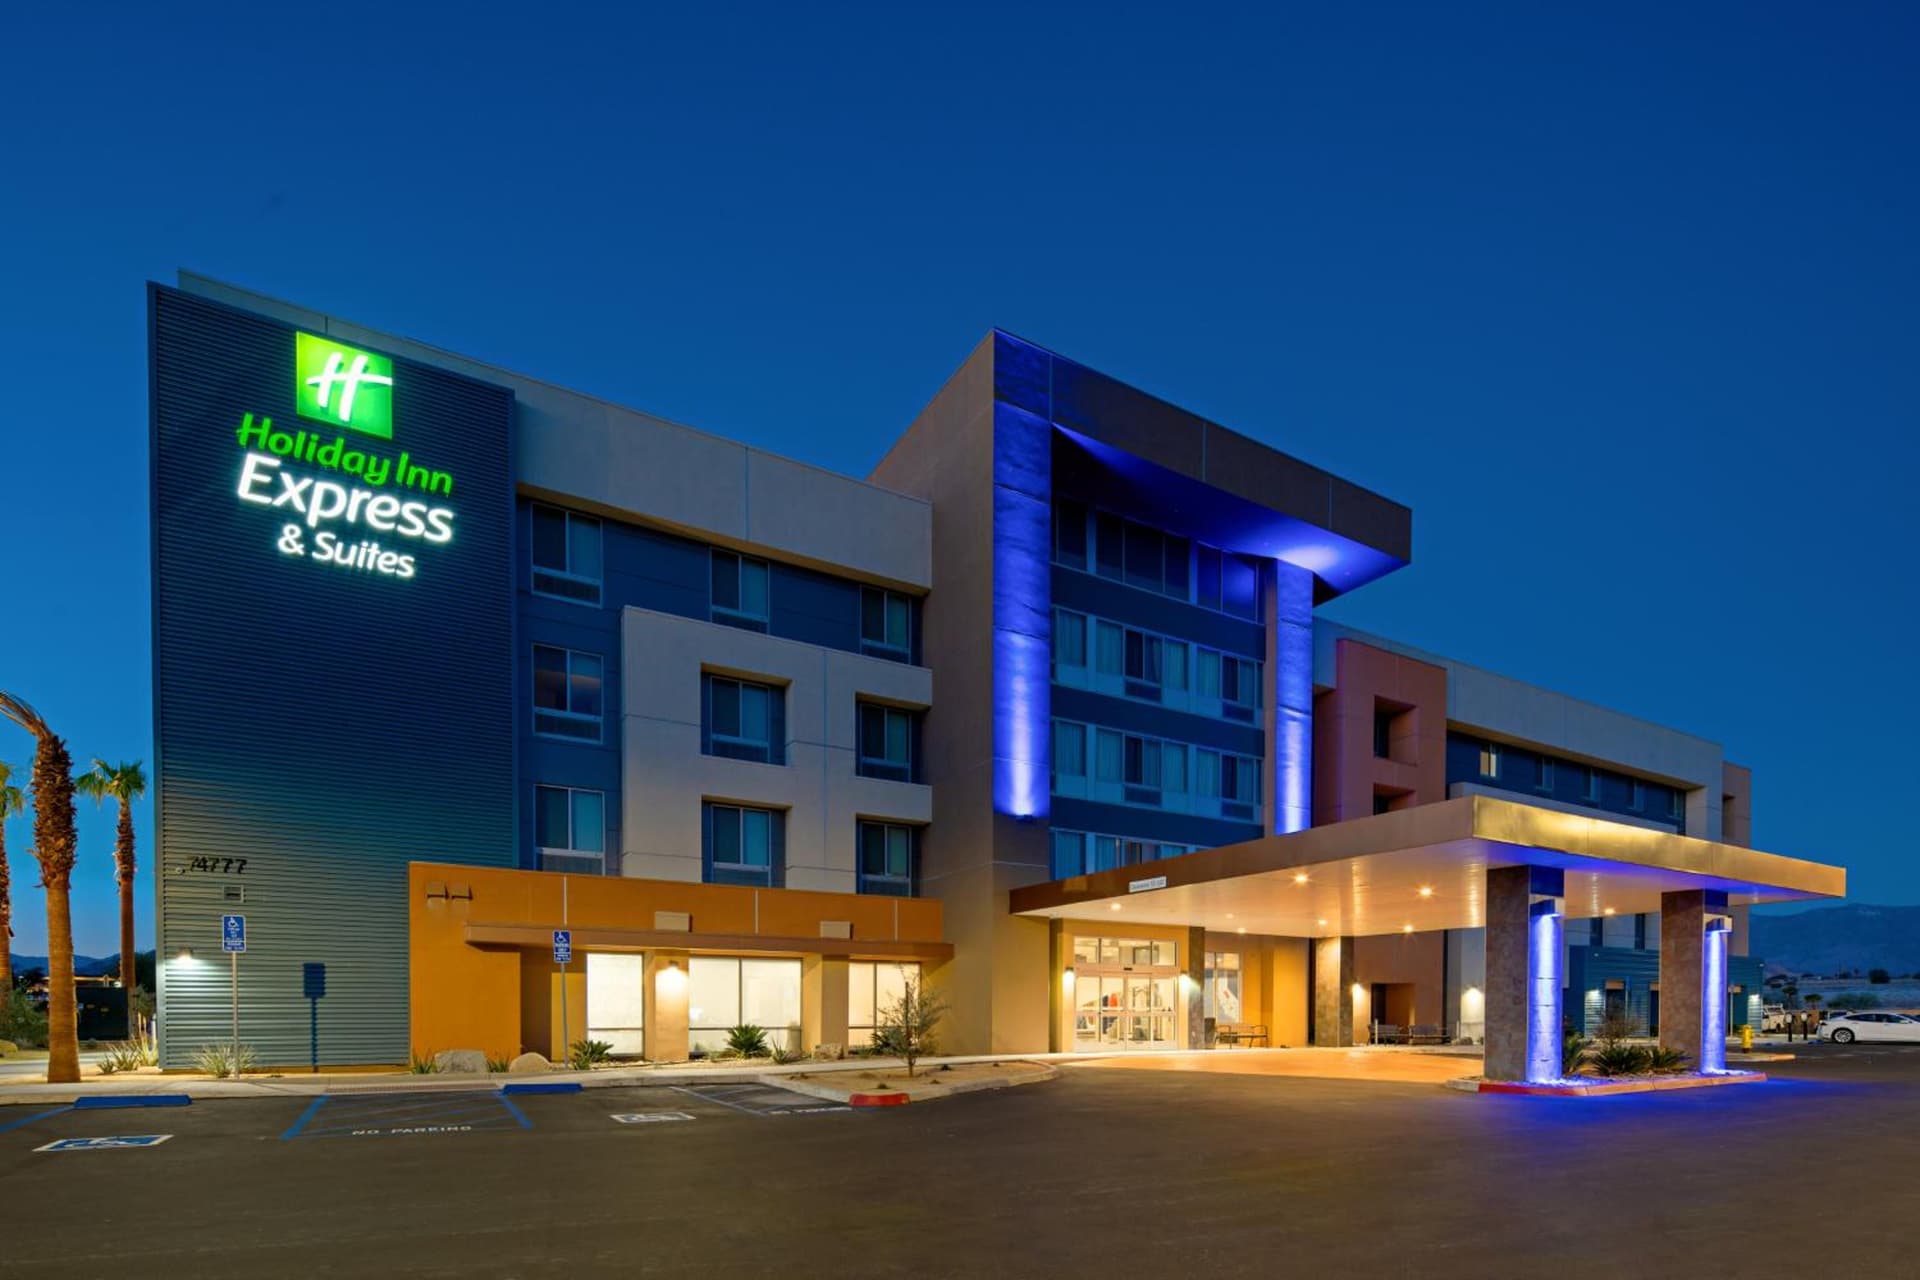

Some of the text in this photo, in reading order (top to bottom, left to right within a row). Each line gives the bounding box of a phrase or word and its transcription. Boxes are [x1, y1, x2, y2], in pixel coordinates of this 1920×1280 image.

[236, 412, 453, 496] Holiday Inn
[236, 452, 454, 543] Express
[277, 523, 414, 578] & Suites
